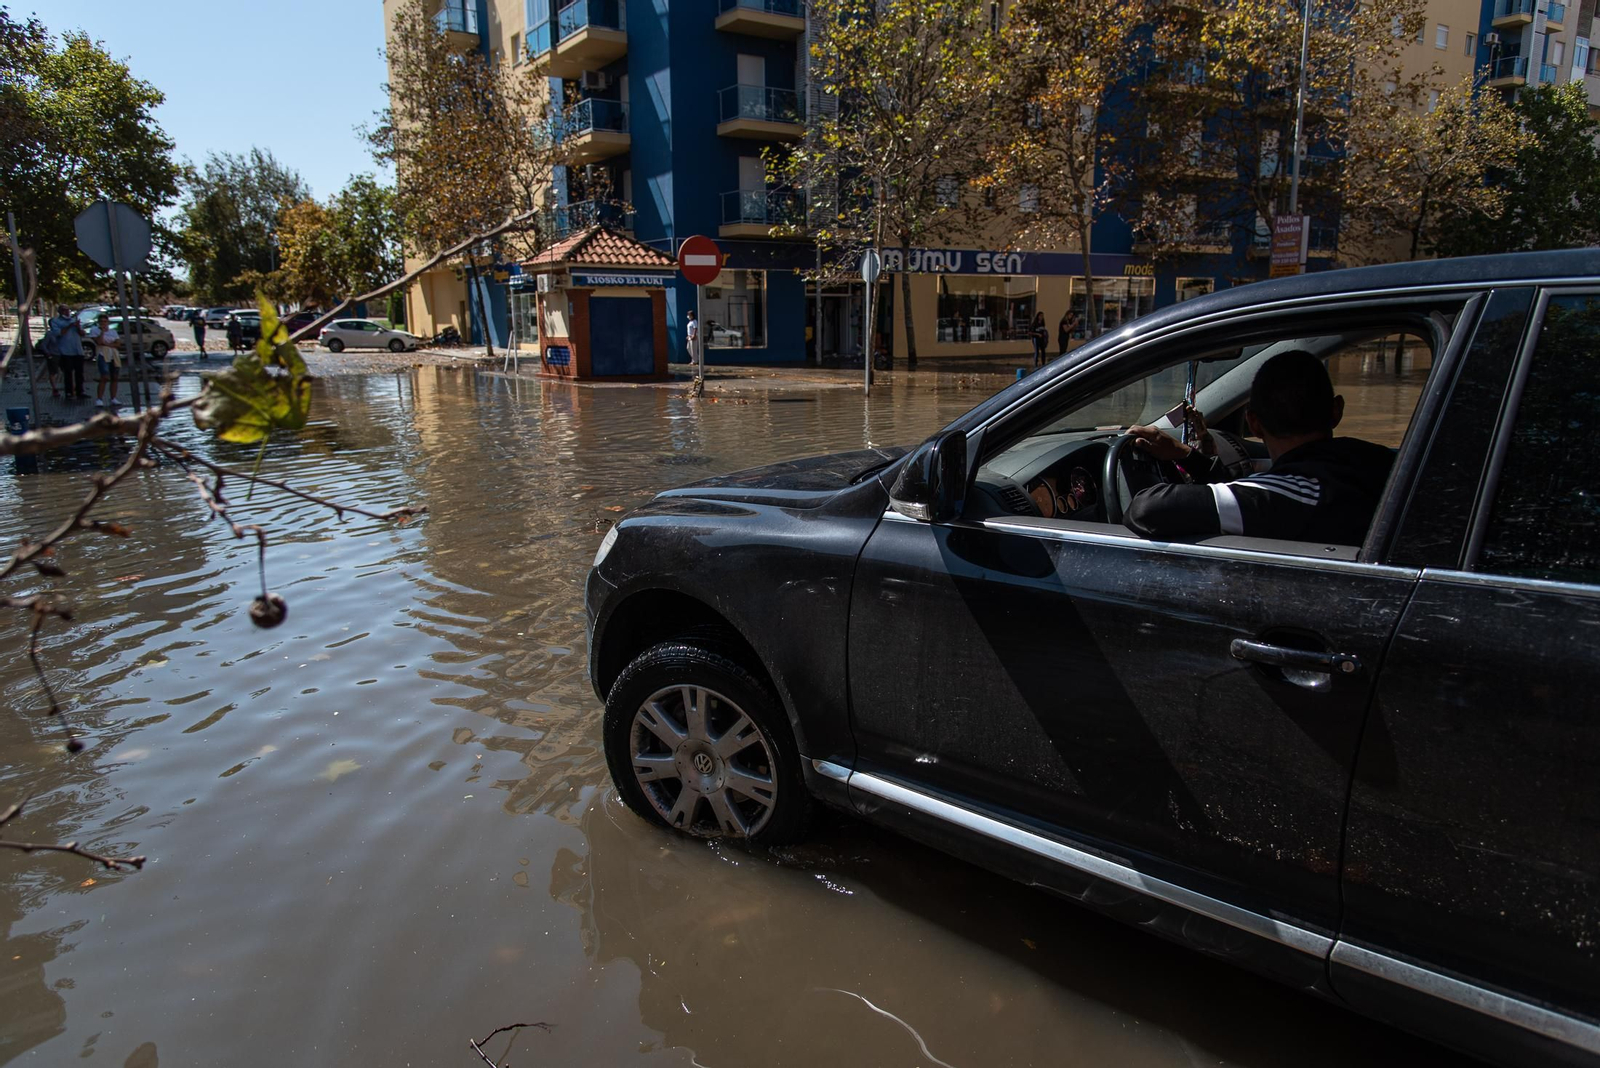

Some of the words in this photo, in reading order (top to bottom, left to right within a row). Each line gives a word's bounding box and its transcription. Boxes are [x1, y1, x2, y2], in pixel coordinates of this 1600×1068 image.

[1277, 215, 1300, 224] Pollos
[1274, 224, 1302, 233] Asados
[1124, 262, 1154, 276] moda
[586, 276, 625, 284] KIOSKO
[626, 277, 638, 285] EL
[639, 277, 664, 286] KUKI
